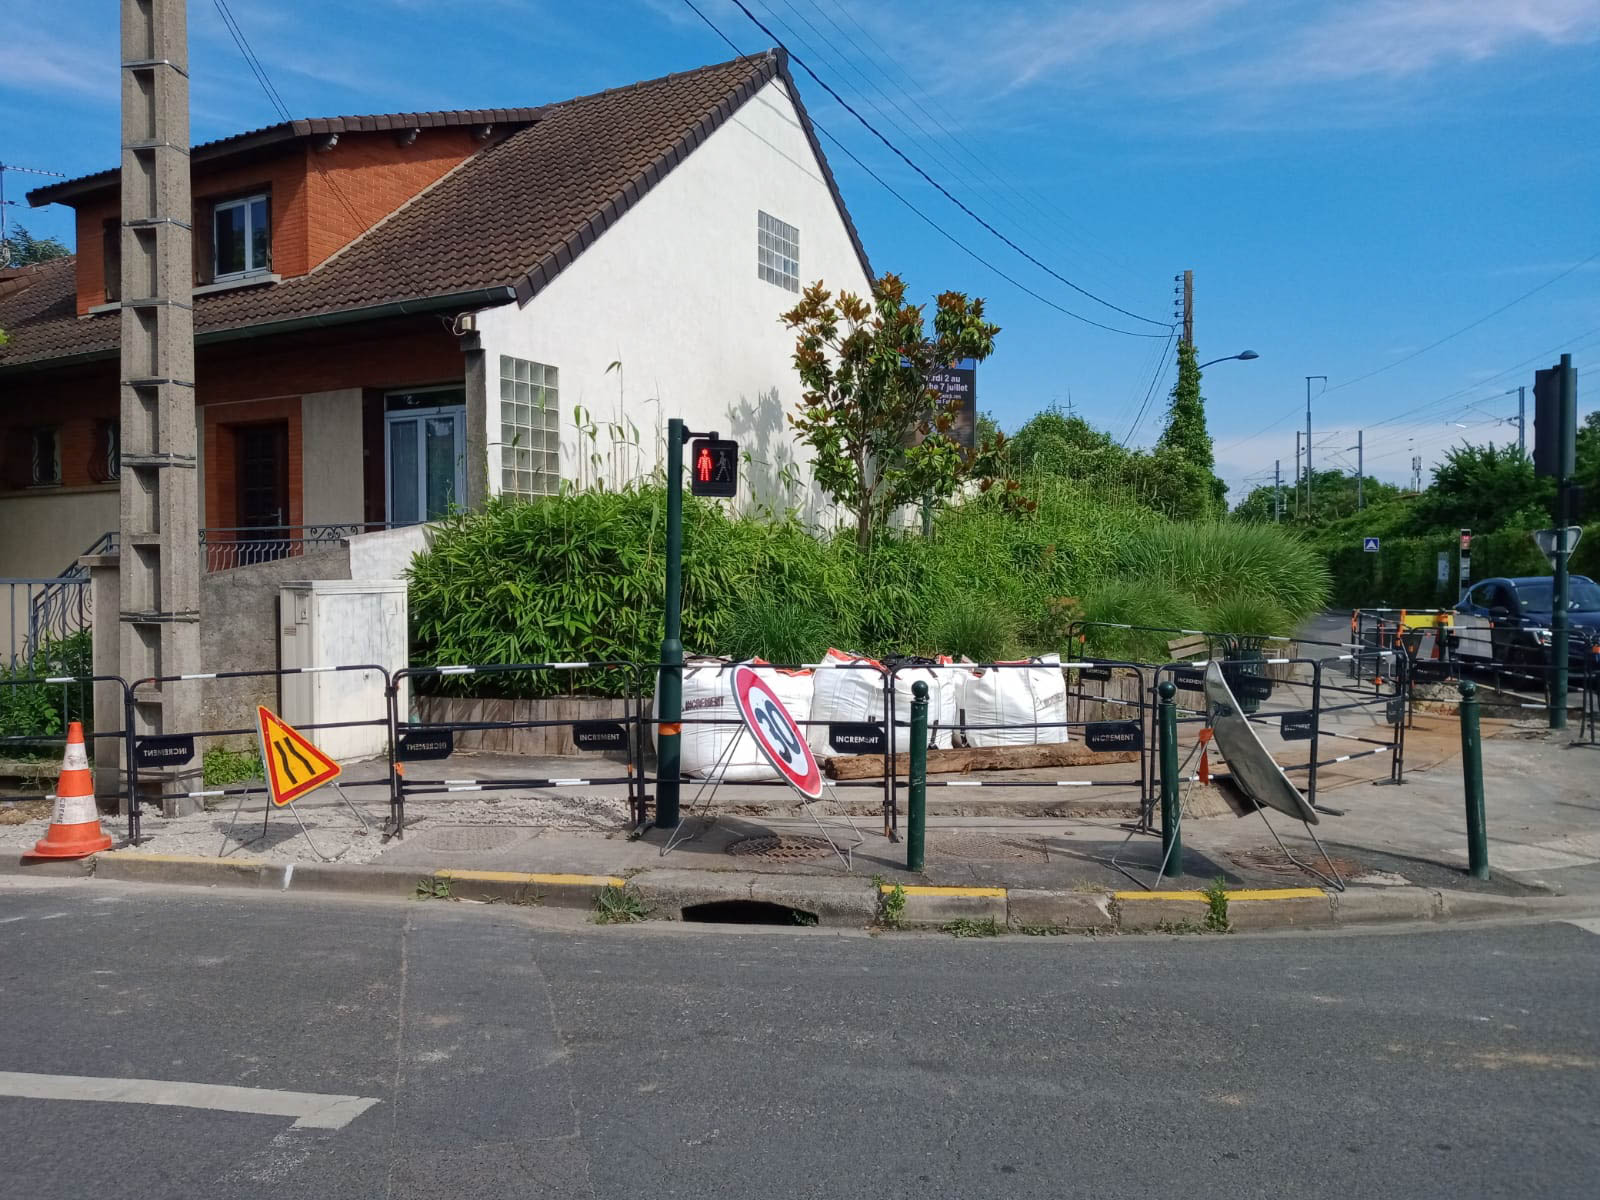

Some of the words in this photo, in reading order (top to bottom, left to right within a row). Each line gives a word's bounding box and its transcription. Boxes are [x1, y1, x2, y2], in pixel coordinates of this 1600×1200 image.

[944, 374, 950, 382] 2
[939, 383, 945, 391] 7
[946, 383, 968, 392] juillet
[755, 700, 801, 764] 30
[579, 733, 620, 741] INCREMENT
[835, 735, 880, 744] INCREMENT
[1091, 733, 1135, 743] INCREMENT
